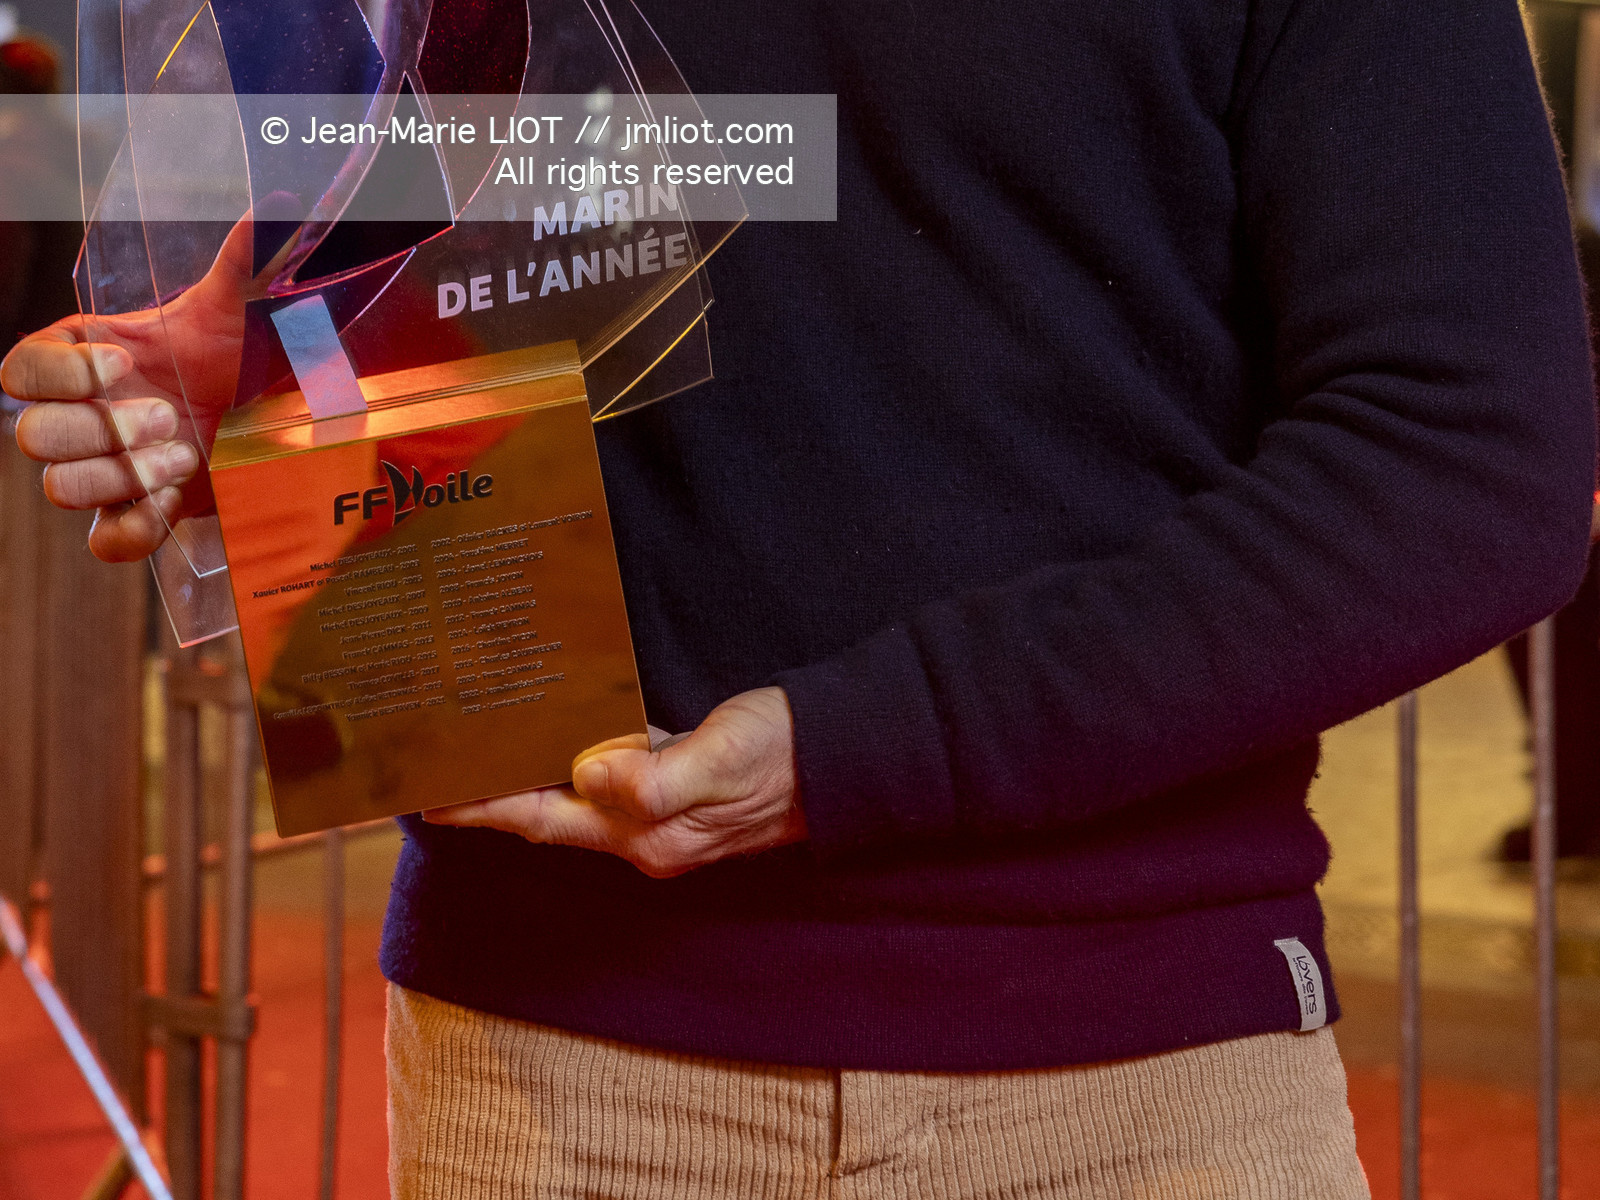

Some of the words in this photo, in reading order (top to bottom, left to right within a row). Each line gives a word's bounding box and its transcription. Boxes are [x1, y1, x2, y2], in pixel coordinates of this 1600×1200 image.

[532, 181, 679, 242] MARIN
[437, 273, 494, 319] DE
[280, 578, 314, 593] ROHART
